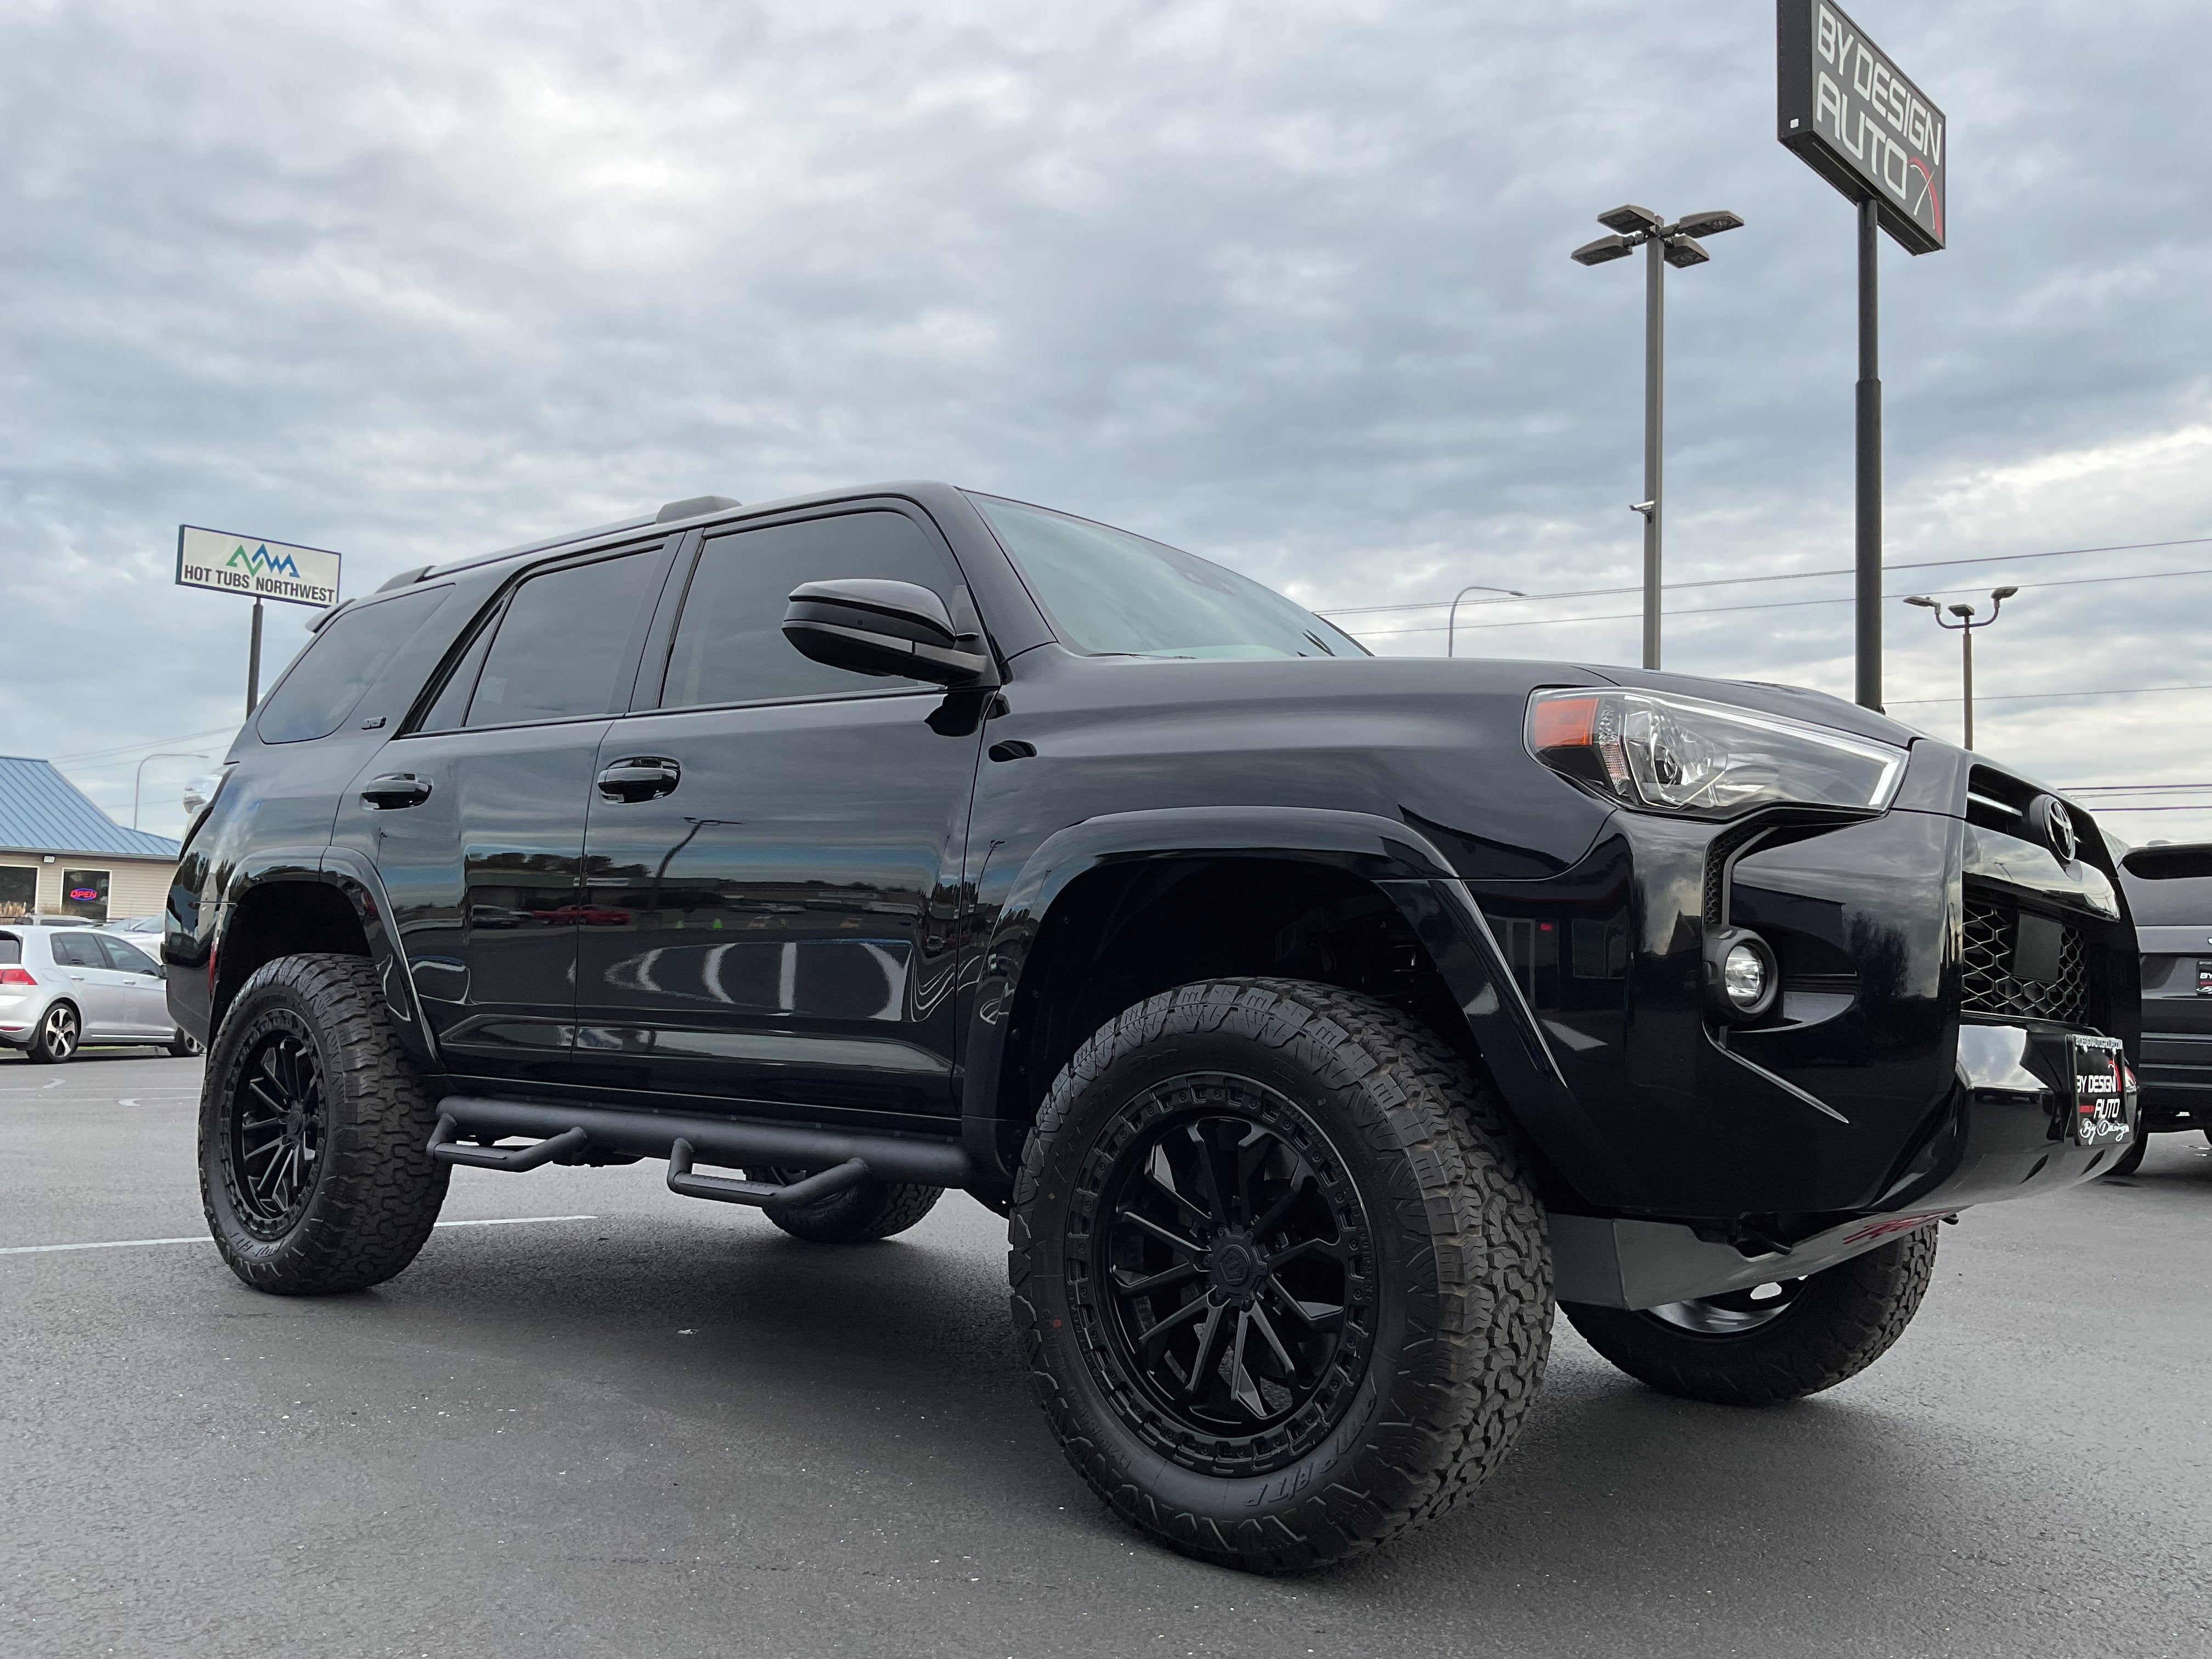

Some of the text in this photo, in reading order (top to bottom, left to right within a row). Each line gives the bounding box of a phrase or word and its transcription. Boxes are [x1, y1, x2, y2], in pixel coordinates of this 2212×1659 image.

[1817, 3, 1942, 166] BY DESIGN
[1816, 71, 1908, 200] AUTO
[184, 565, 335, 602] HOT TUBS NORTHWEST
[70, 890, 97, 898] OPEN
[2088, 1075, 2117, 1093] DESIGN
[2094, 1098, 2120, 1119] AUTO
